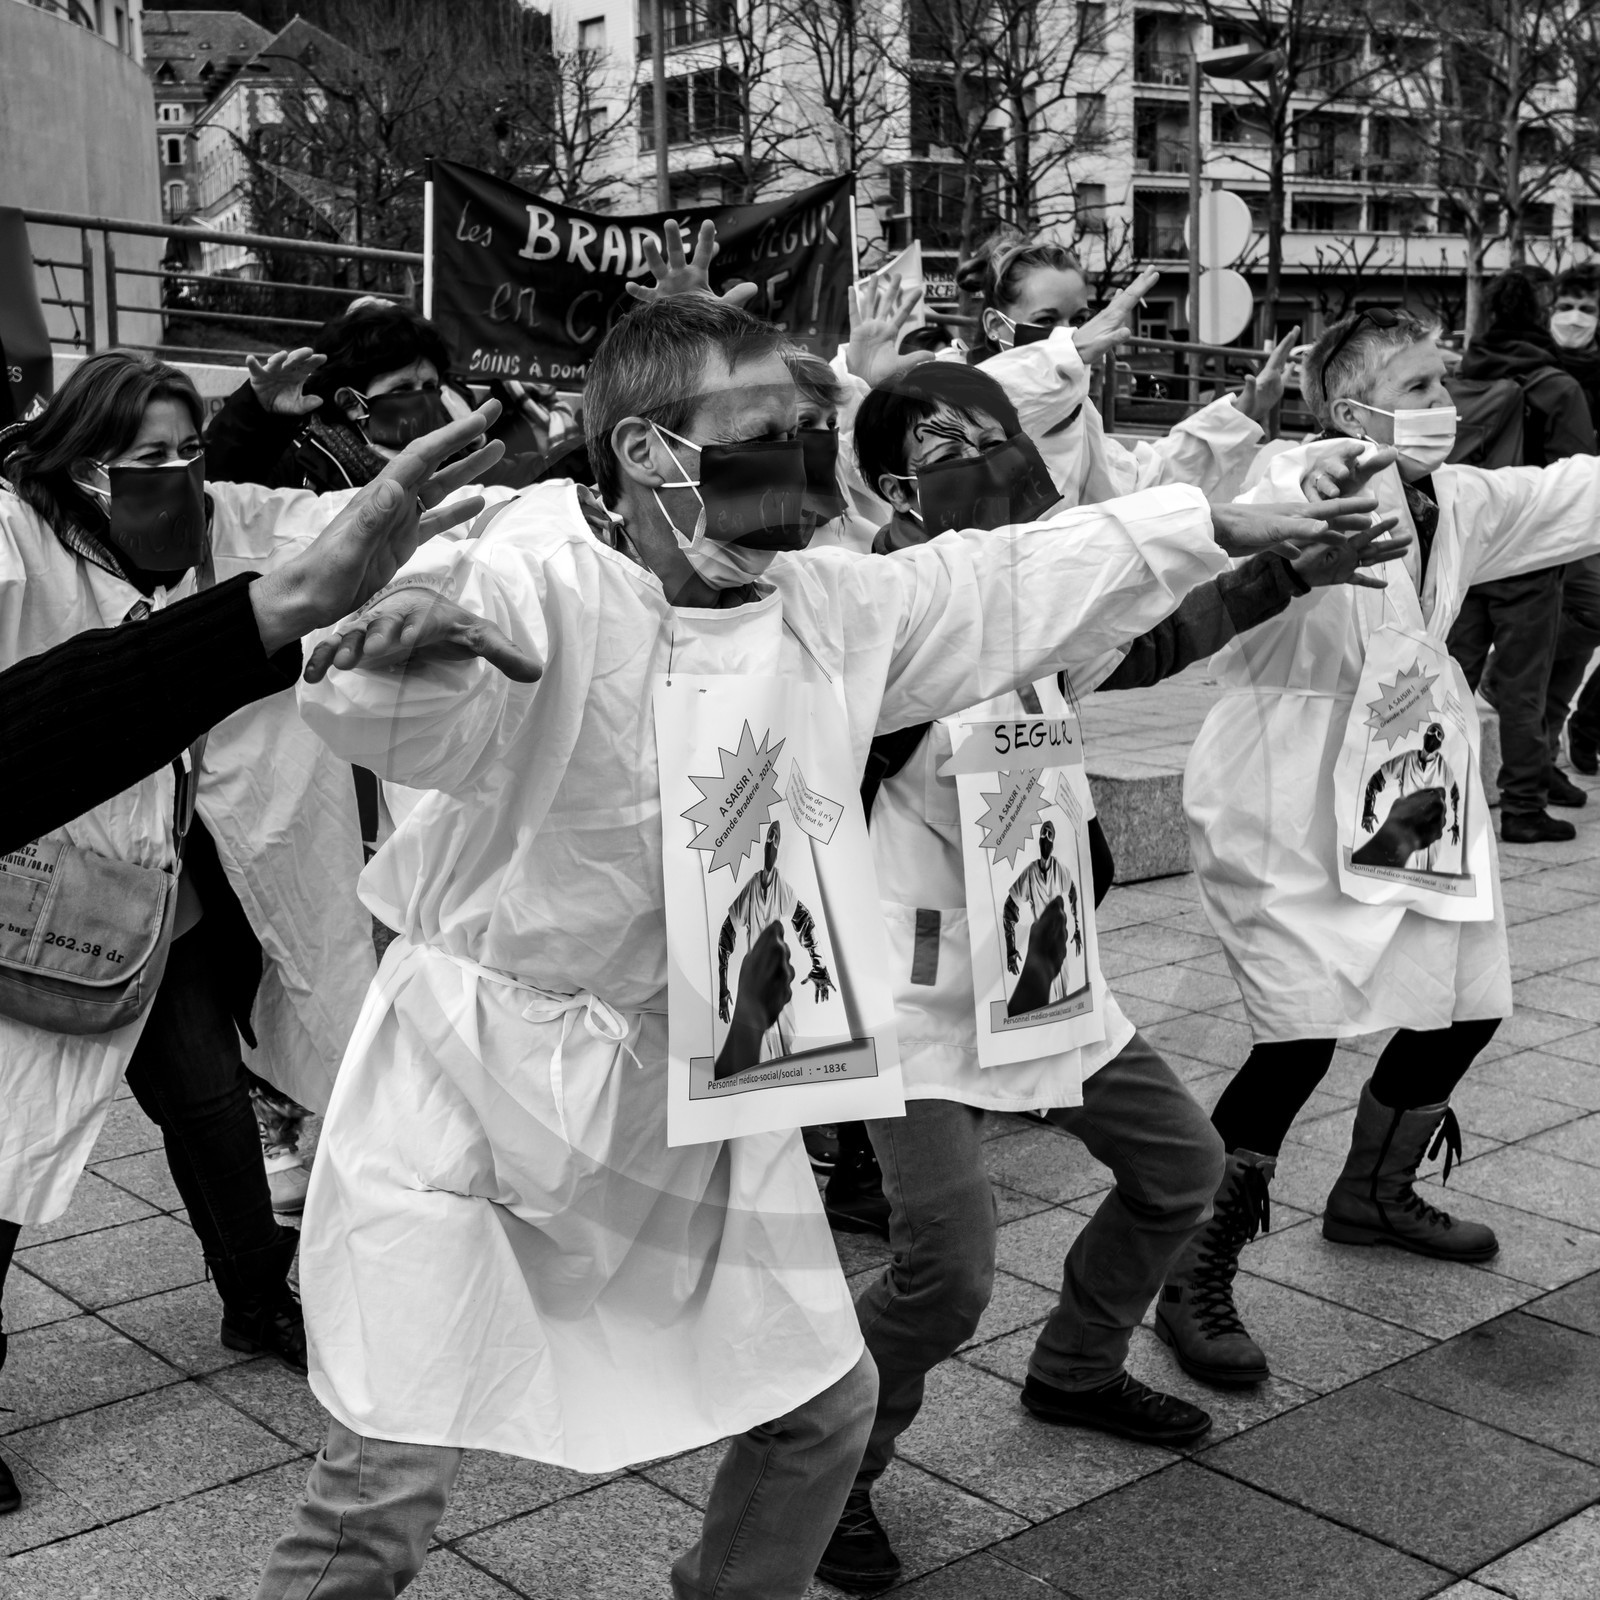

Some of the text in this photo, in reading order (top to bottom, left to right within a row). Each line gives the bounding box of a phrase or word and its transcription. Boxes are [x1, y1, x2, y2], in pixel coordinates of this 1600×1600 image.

[456, 200, 492, 248] Les
[518, 205, 721, 279] BRADÉ
[469, 348, 520, 376] SOINS
[529, 356, 543, 378] À
[994, 720, 1073, 755] SEGUR
[714, 759, 774, 849] Grande Braderie 2021
[719, 806, 729, 818] A
[726, 775, 750, 809] SAISIR
[8, 922, 28, 937] bag
[44, 931, 125, 964] 262.38 dr
[707, 1076, 738, 1091] Personnel
